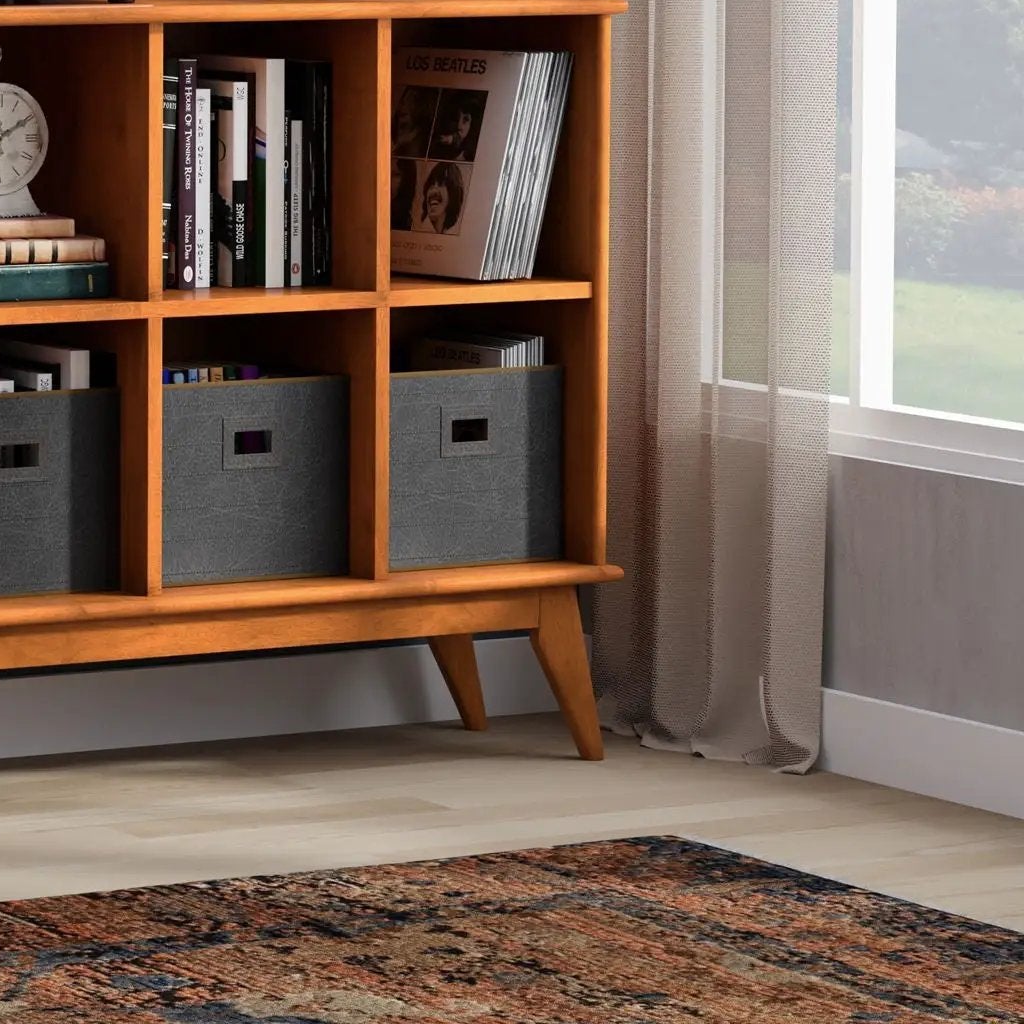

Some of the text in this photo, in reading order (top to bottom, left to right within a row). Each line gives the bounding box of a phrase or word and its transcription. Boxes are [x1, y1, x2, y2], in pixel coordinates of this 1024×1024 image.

[406, 55, 488, 75] LOS BEATLES
[235, 202, 245, 260] WILD GOOSE CHASE
